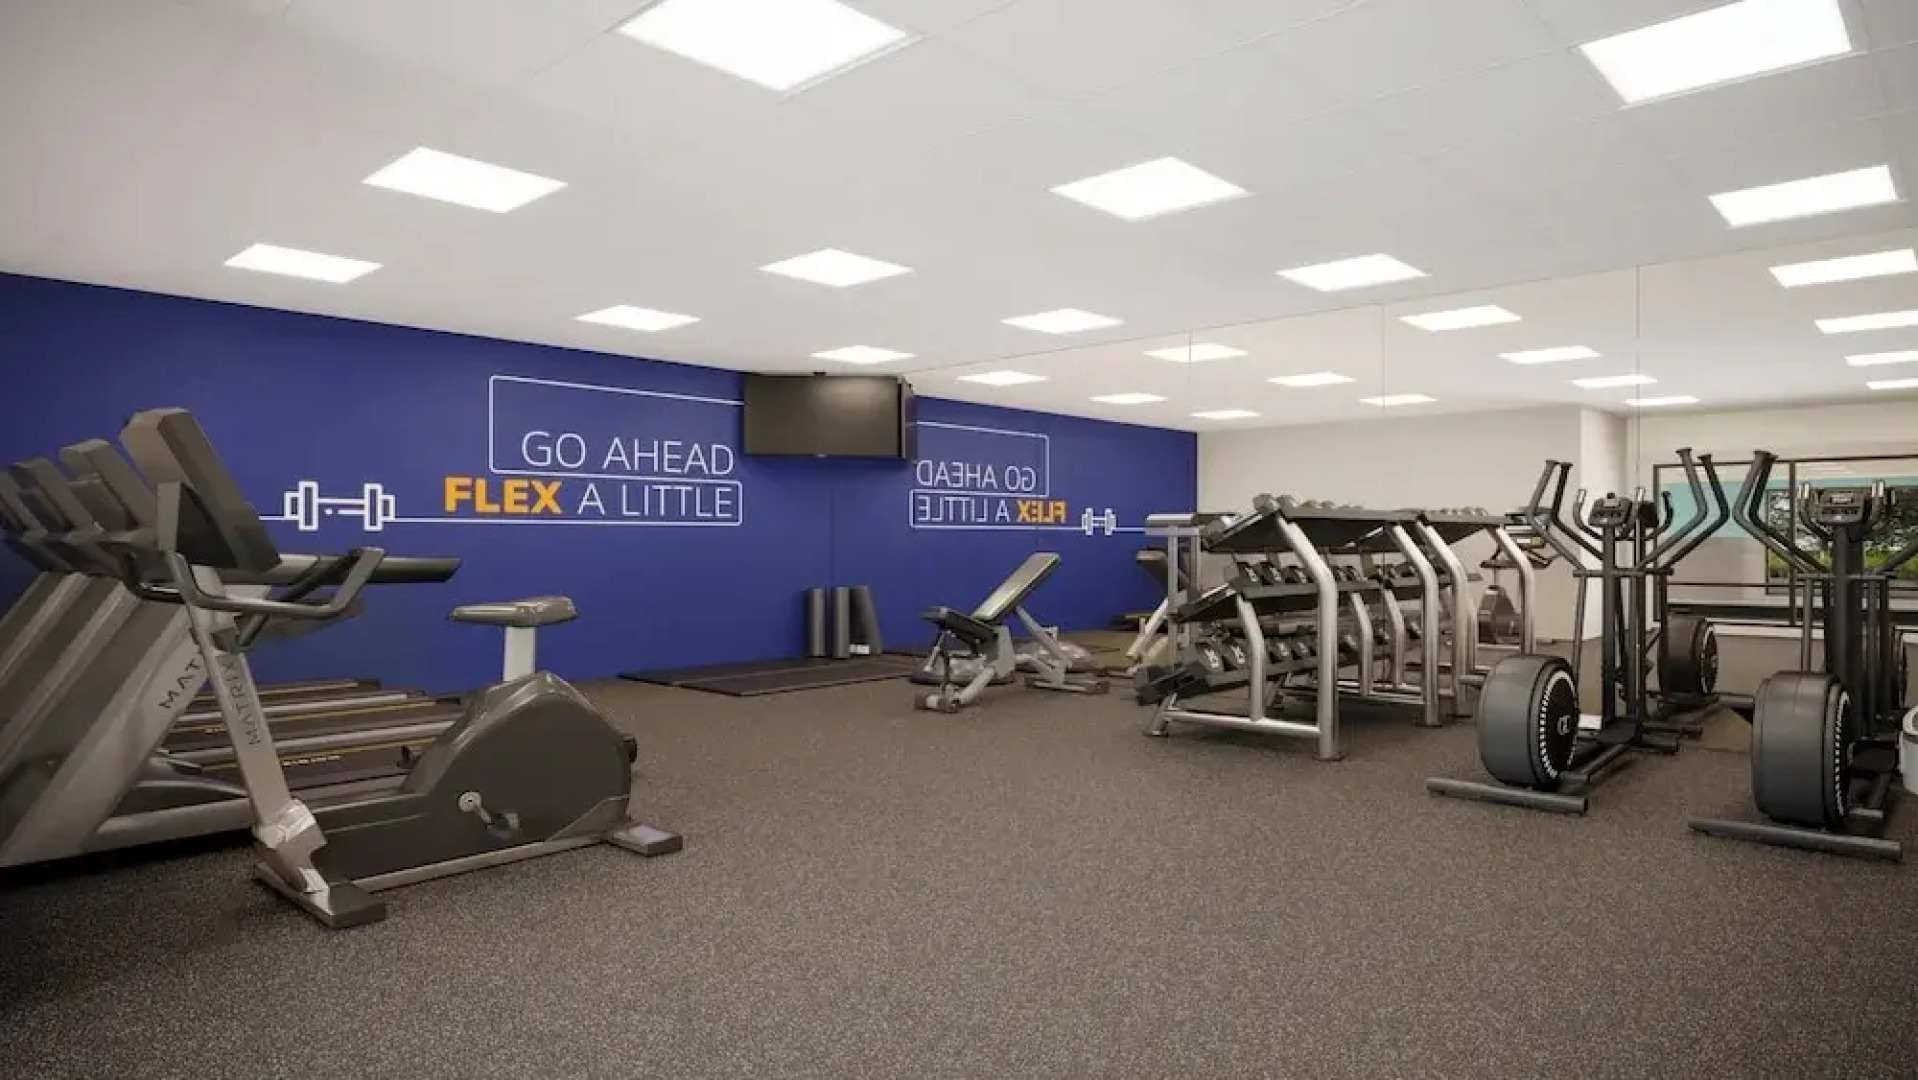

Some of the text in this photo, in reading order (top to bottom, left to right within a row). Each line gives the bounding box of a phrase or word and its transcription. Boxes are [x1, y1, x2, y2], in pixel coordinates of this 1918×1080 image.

[521, 430, 734, 475] GO AHEAD
[444, 476, 733, 517] FLEX A LITTLE
[158, 657, 200, 709] MAT
[222, 660, 262, 745] MATRIX
